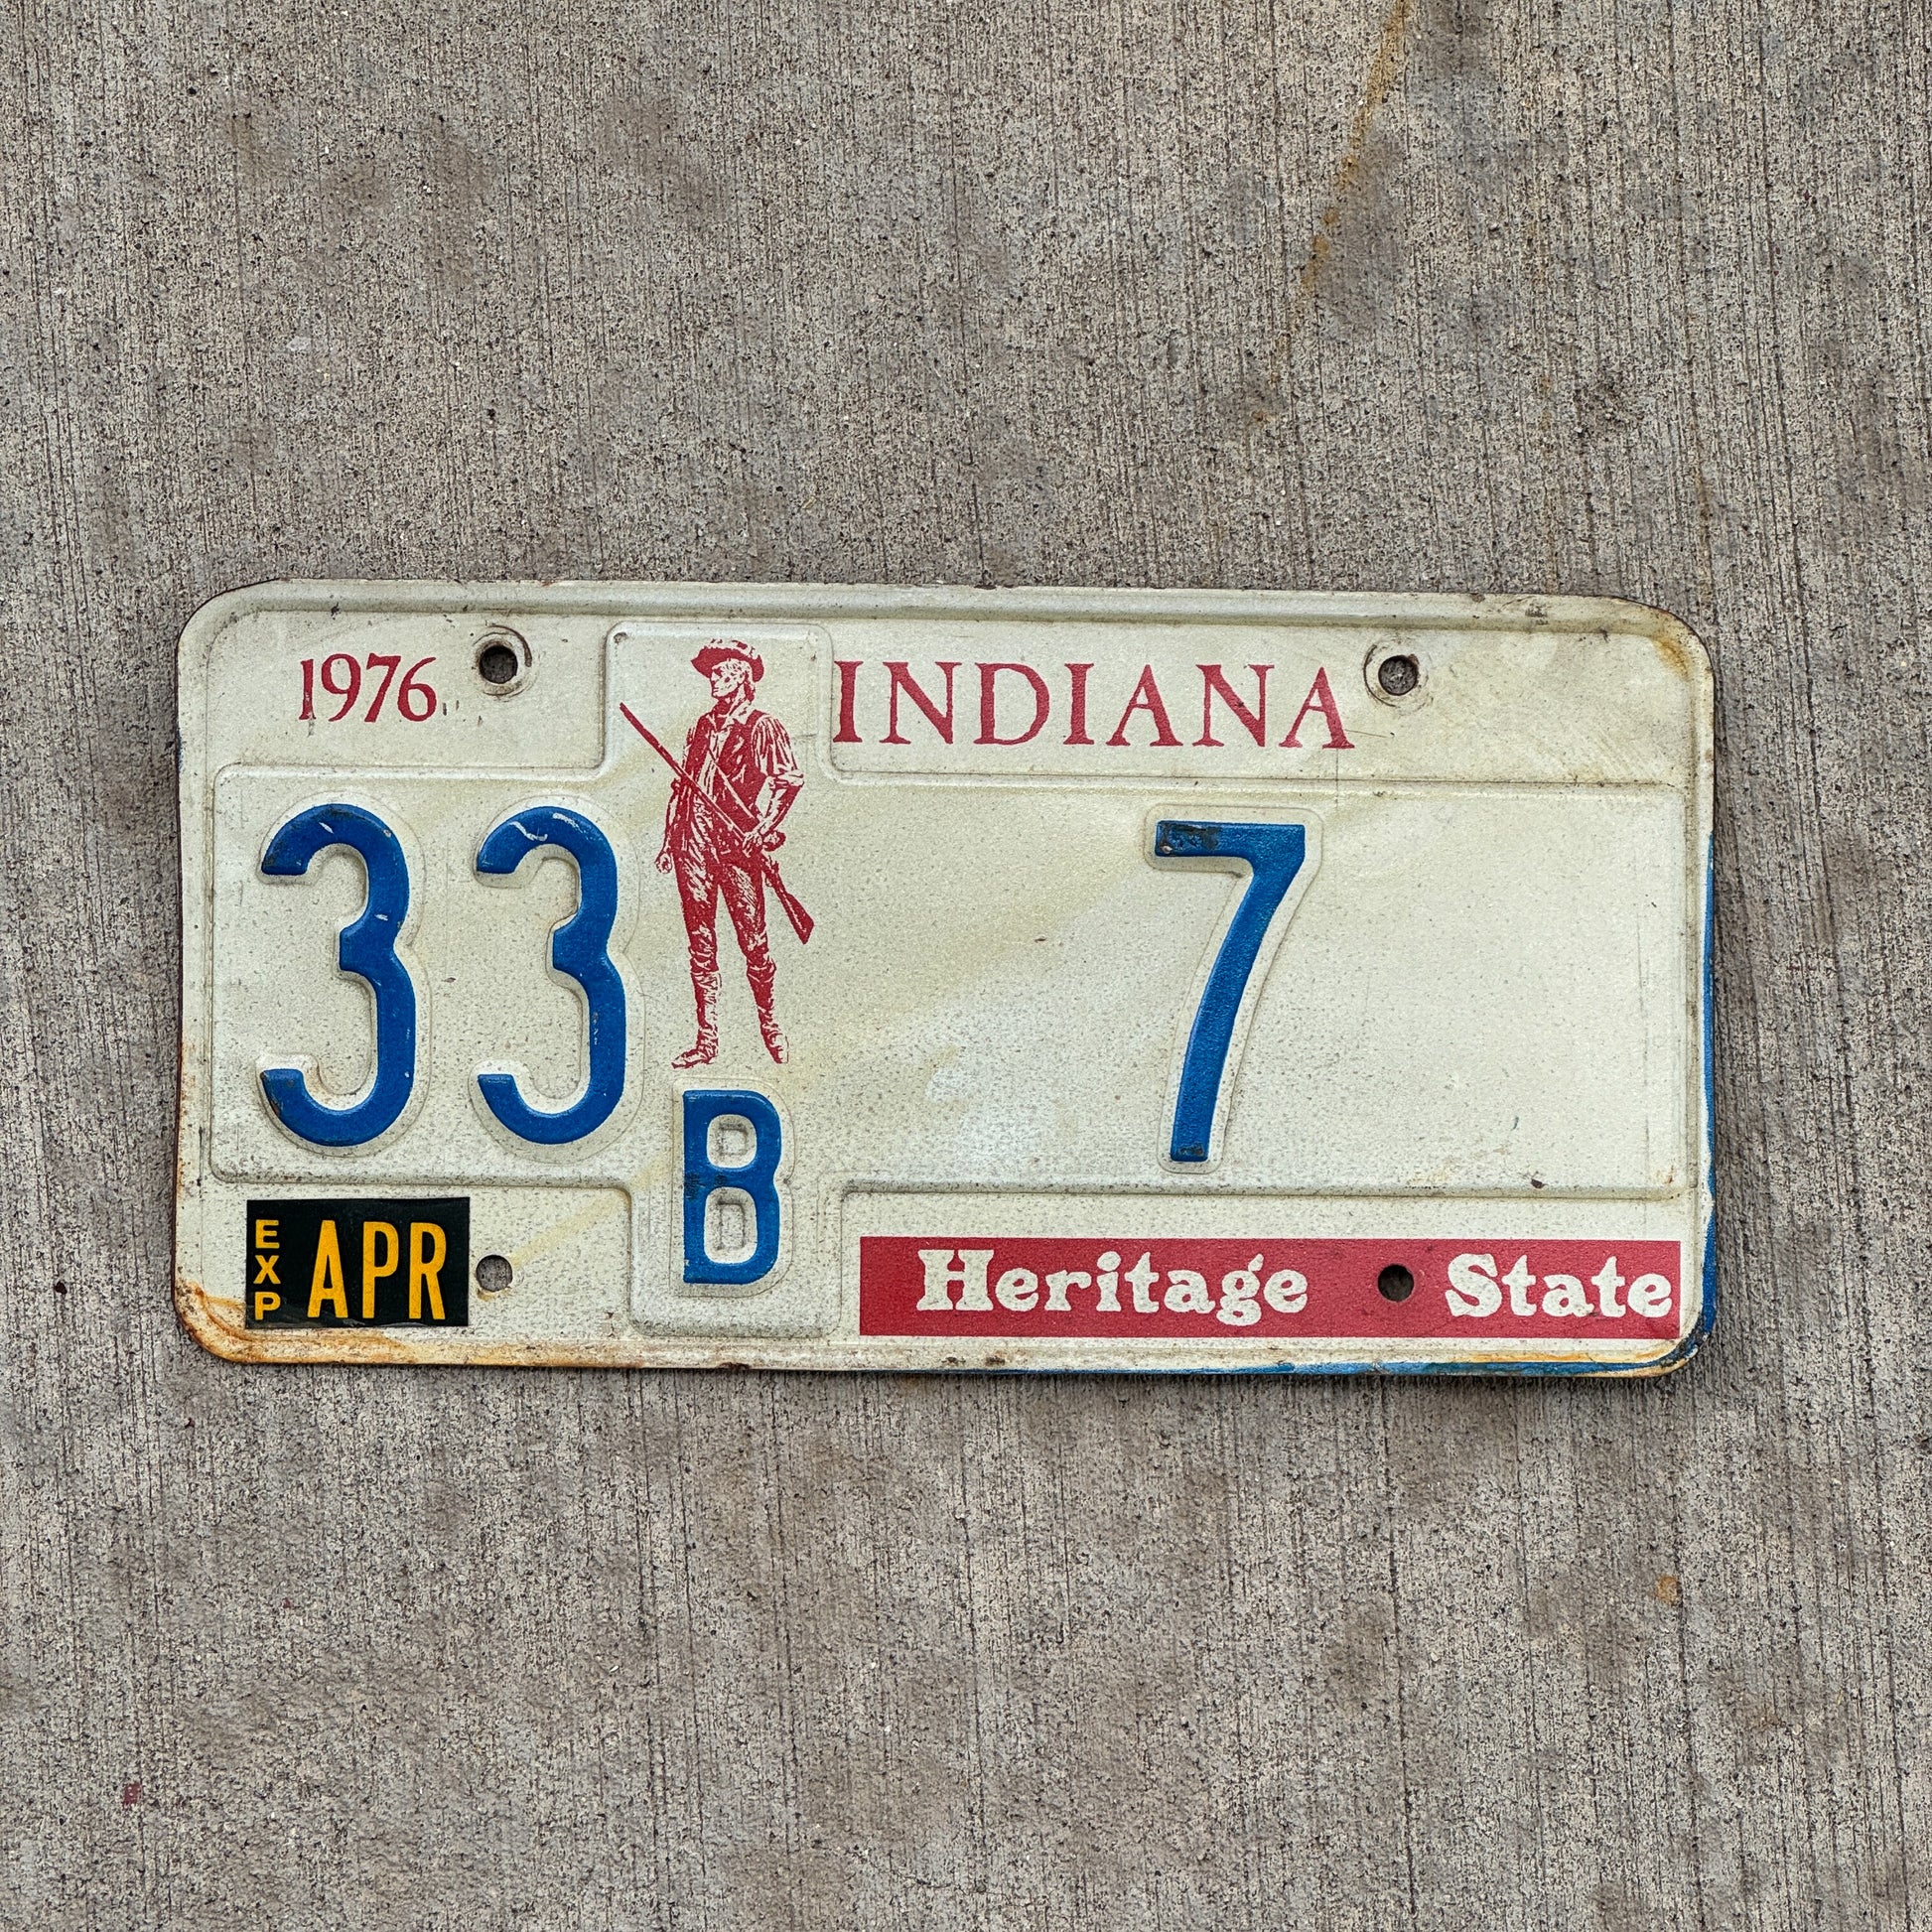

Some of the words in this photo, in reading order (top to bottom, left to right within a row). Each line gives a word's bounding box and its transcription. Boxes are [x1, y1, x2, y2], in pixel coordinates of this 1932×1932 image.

[300, 653, 438, 724] 1976
[831, 660, 1355, 750] INDIANA
[260, 802, 627, 1149] 33
[681, 1088, 783, 1287] B
[1153, 820, 1307, 1163] 7
[253, 1219, 282, 1321] EXP
[306, 1219, 449, 1321] APR
[916, 1247, 1309, 1326] Heritage
[1445, 1251, 1673, 1319] State
